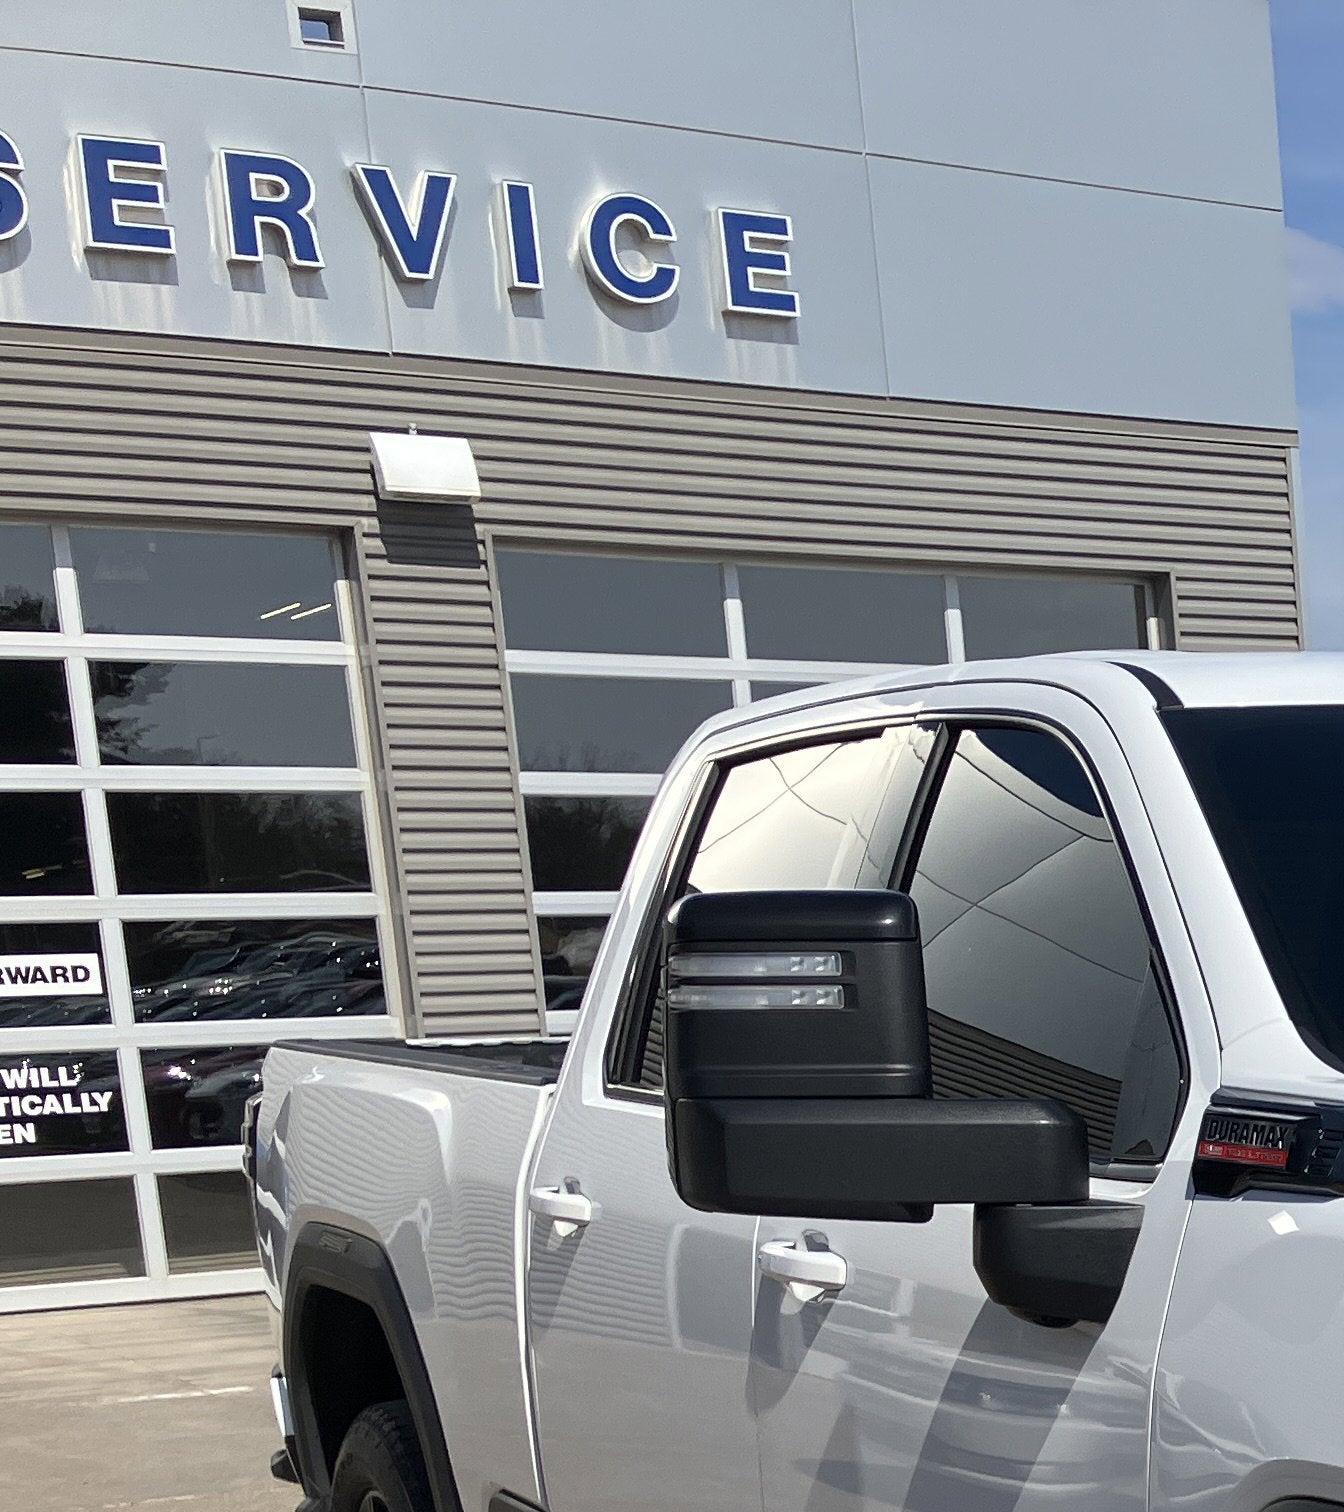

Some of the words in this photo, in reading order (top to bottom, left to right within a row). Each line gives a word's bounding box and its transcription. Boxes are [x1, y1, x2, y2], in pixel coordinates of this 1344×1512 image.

[0, 965, 91, 986] WARD
[0, 1066, 78, 1090] WILL
[1206, 1120, 1289, 1150] DURAMAX
